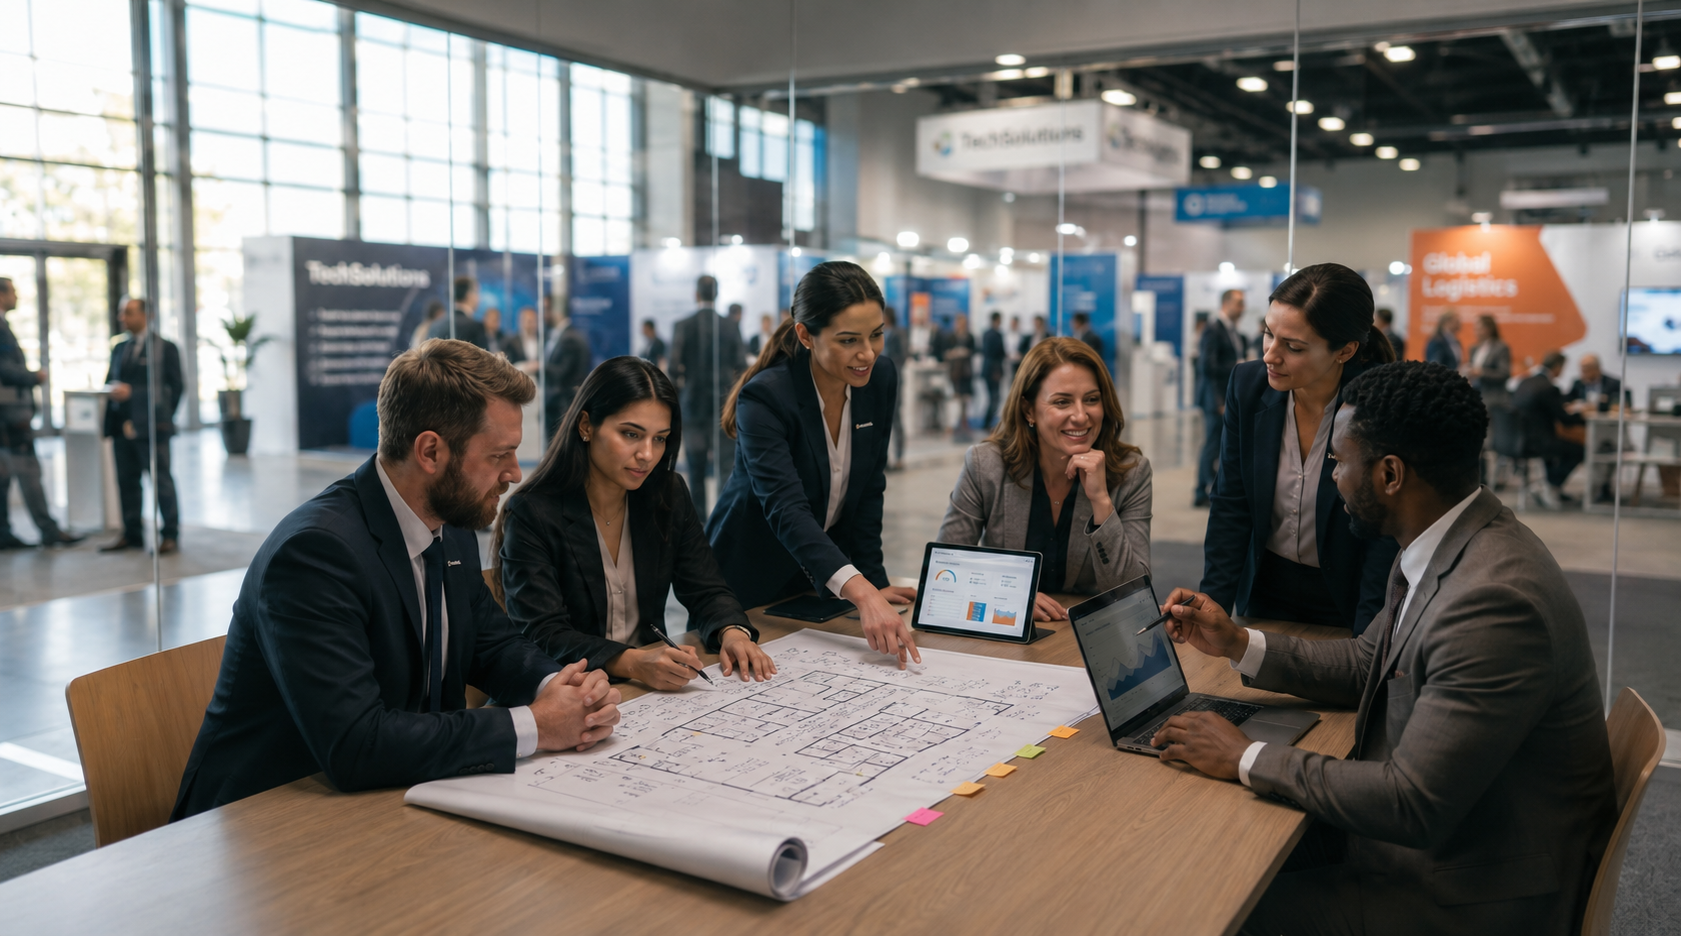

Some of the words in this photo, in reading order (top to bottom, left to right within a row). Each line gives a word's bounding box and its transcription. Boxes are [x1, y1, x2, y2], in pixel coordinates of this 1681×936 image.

[961, 125, 1085, 149] TechSolutions
[305, 260, 430, 288] TechSolutions
[1422, 251, 1491, 275] Global
[1421, 275, 1518, 302] Logistics
